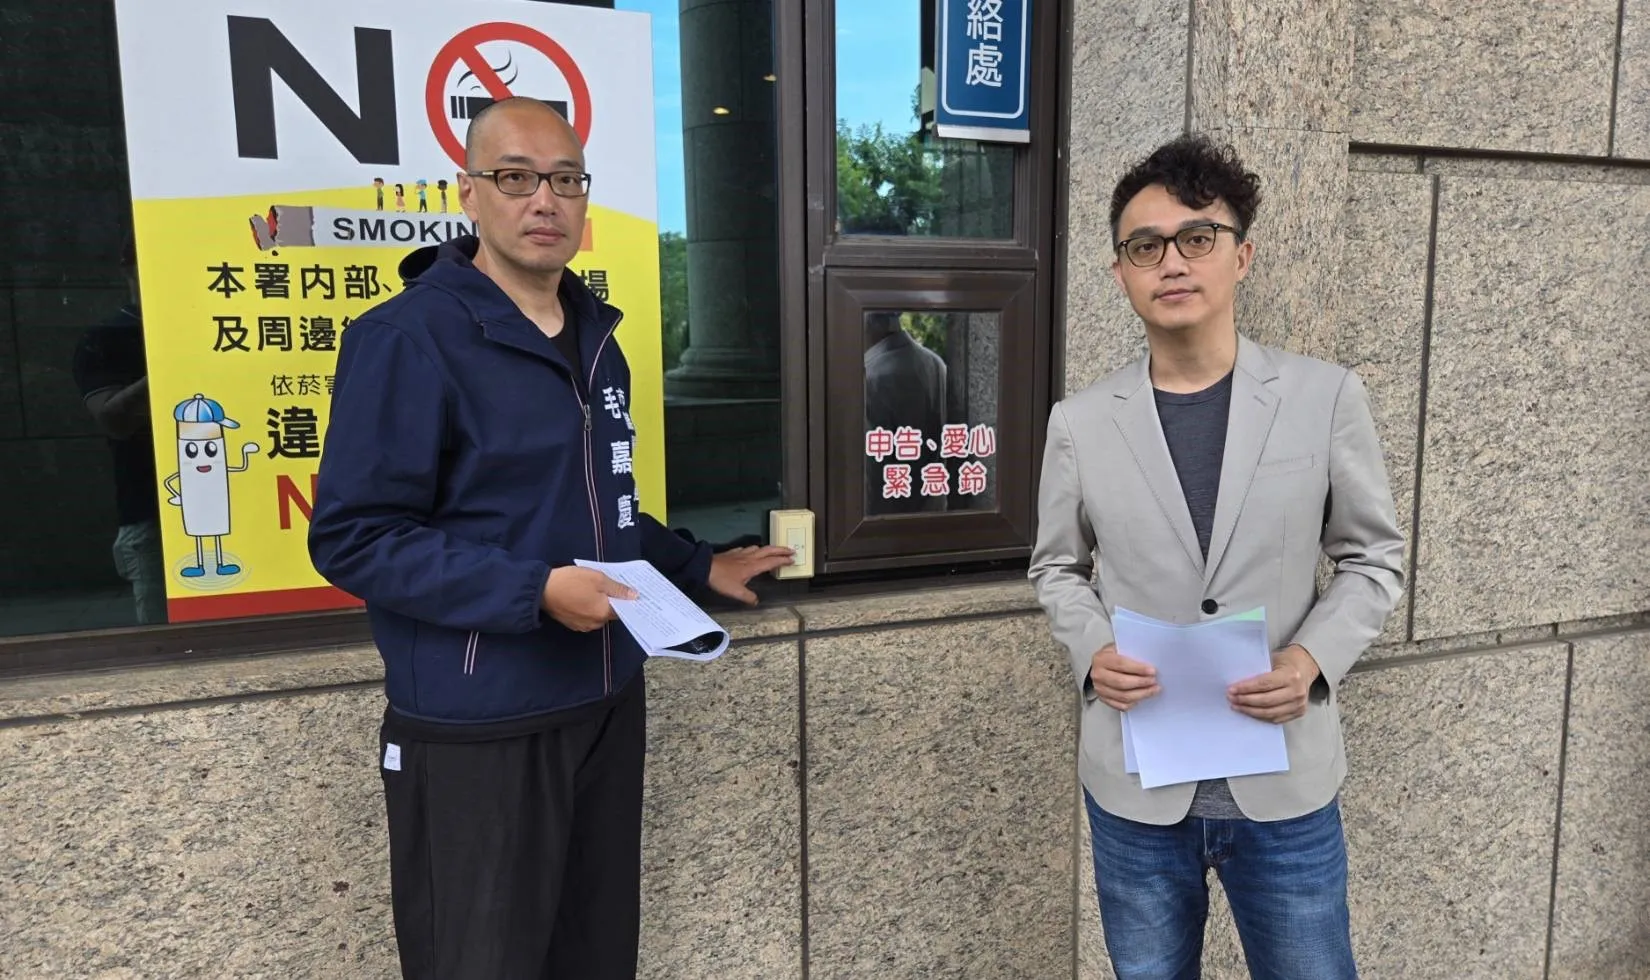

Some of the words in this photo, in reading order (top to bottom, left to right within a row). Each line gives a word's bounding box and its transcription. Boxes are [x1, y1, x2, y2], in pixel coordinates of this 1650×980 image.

[965, 0, 1004, 88] 絡處
[227, 14, 400, 166] N
[213, 315, 354, 352] 及周邊
[266, 405, 320, 460] 違
[866, 424, 996, 461] 申告、愛心
[276, 473, 319, 530] N
[883, 461, 987, 498] 緊急鈴
